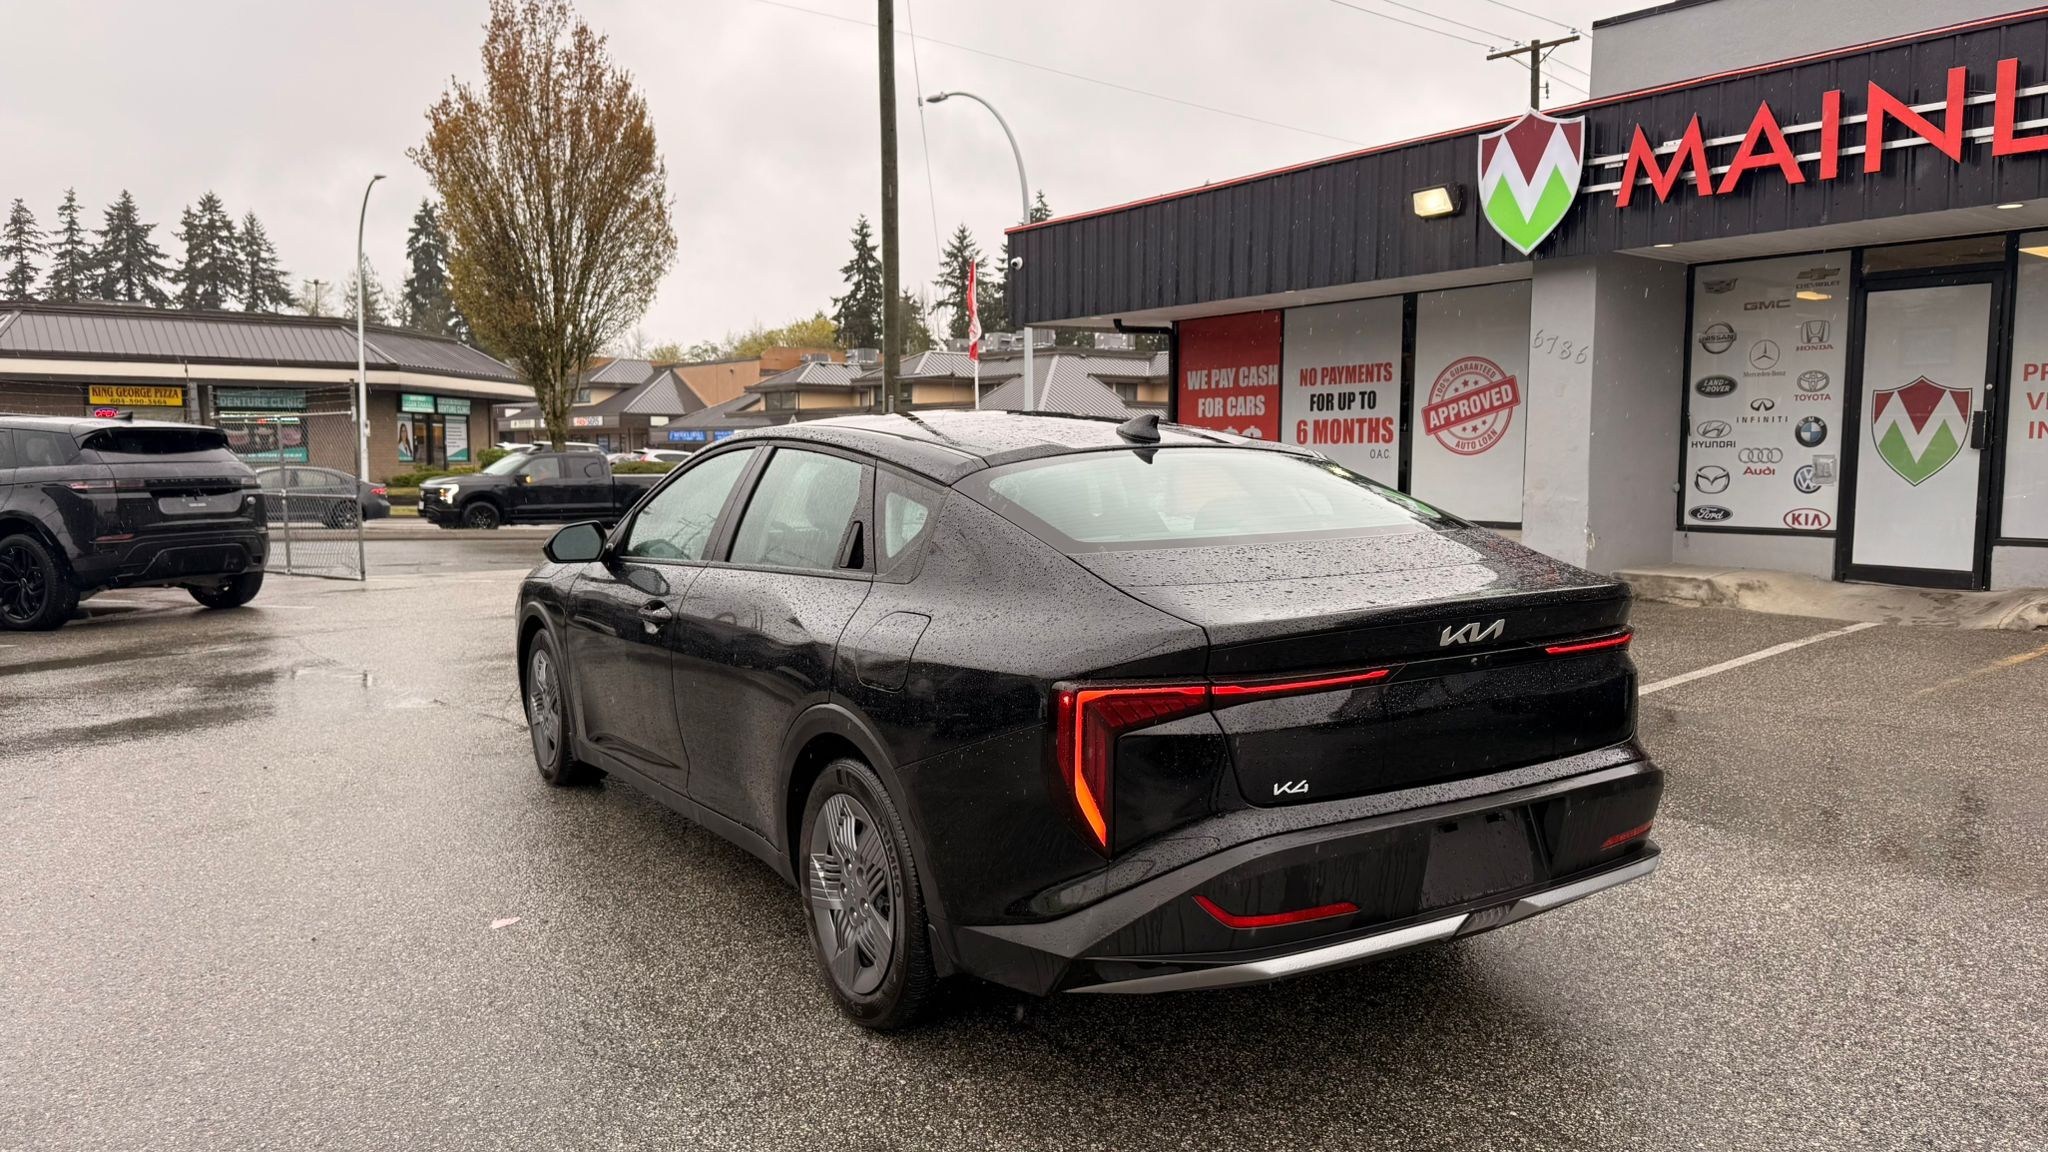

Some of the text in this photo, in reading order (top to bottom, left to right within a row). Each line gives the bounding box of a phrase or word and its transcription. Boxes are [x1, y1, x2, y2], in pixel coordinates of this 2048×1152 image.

[1743, 299, 1792, 311] GMC
[1532, 329, 1590, 365] 6786
[1796, 344, 1834, 352] HONDA
[1187, 364, 1278, 390] WE PAY CASH
[1300, 362, 1393, 387] NO PAYMENTS
[1435, 362, 1497, 397] 100% GUARANTEED
[92, 386, 179, 399] KING GEORGE PIZZA
[1794, 393, 1831, 401] TOYOTA
[2026, 391, 2048, 410] V
[219, 396, 305, 408] DENTURE CLINIC
[1198, 395, 1265, 418] FOR CARS
[1310, 390, 1377, 412] FOR UP TO
[1430, 384, 1513, 429] APPROVED
[95, 409, 119, 418] OPEN
[1296, 417, 1394, 445] 6 MONTHS
[1455, 428, 1498, 450] AUTO LOAN
[1691, 440, 1736, 448] HYUNDAI
[1743, 466, 1776, 476] Audi
[1697, 508, 1724, 520] Ford
[1791, 513, 1822, 527] KIA
[1273, 780, 1309, 796] K4
